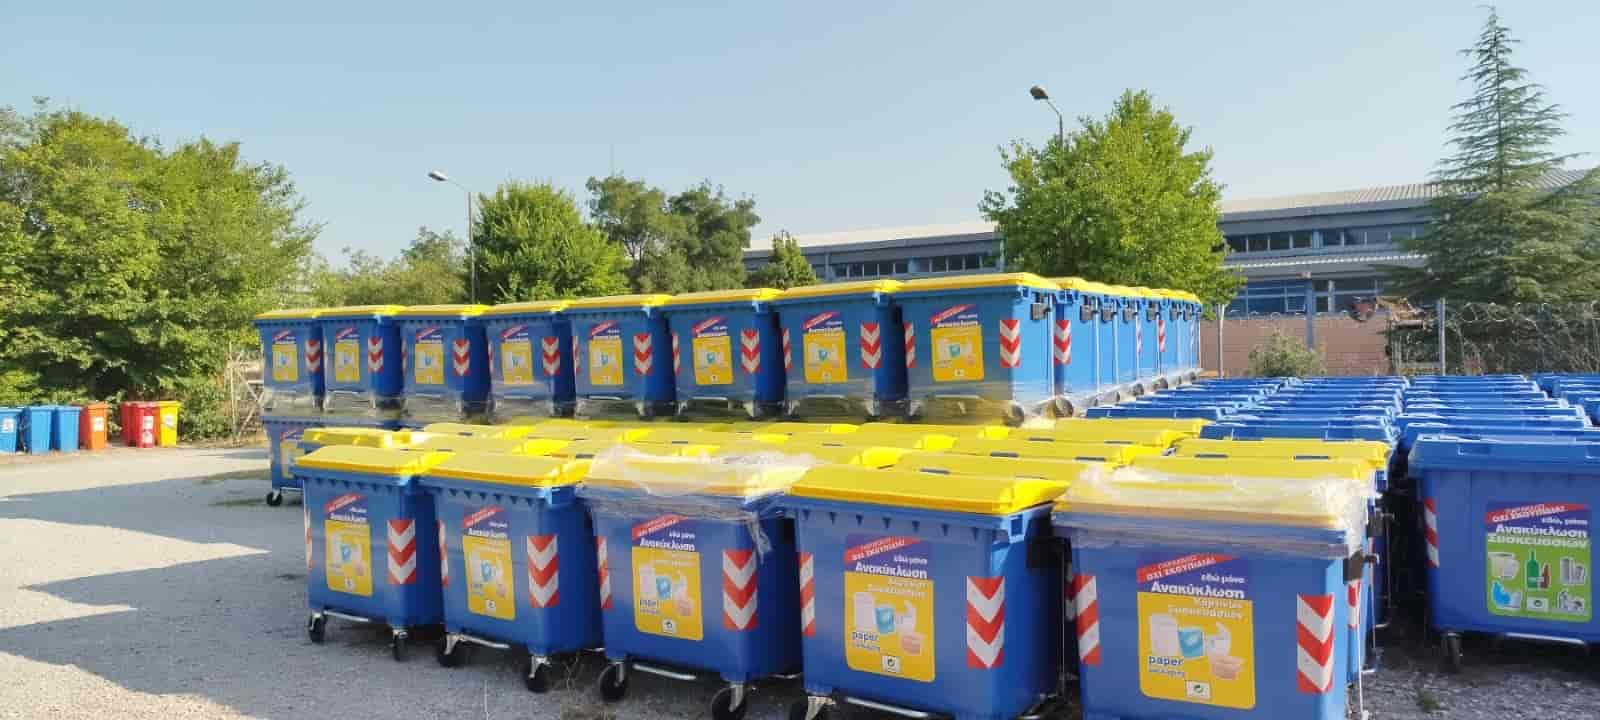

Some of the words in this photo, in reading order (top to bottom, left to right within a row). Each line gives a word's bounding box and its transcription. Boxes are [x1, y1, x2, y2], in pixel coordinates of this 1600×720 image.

[1496, 524, 1588, 538] Ανακύκλωση
[855, 561, 928, 579] Ανακύκλωση
[1151, 581, 1245, 599] Ανακύκλωση
[1148, 655, 1185, 668] paper
